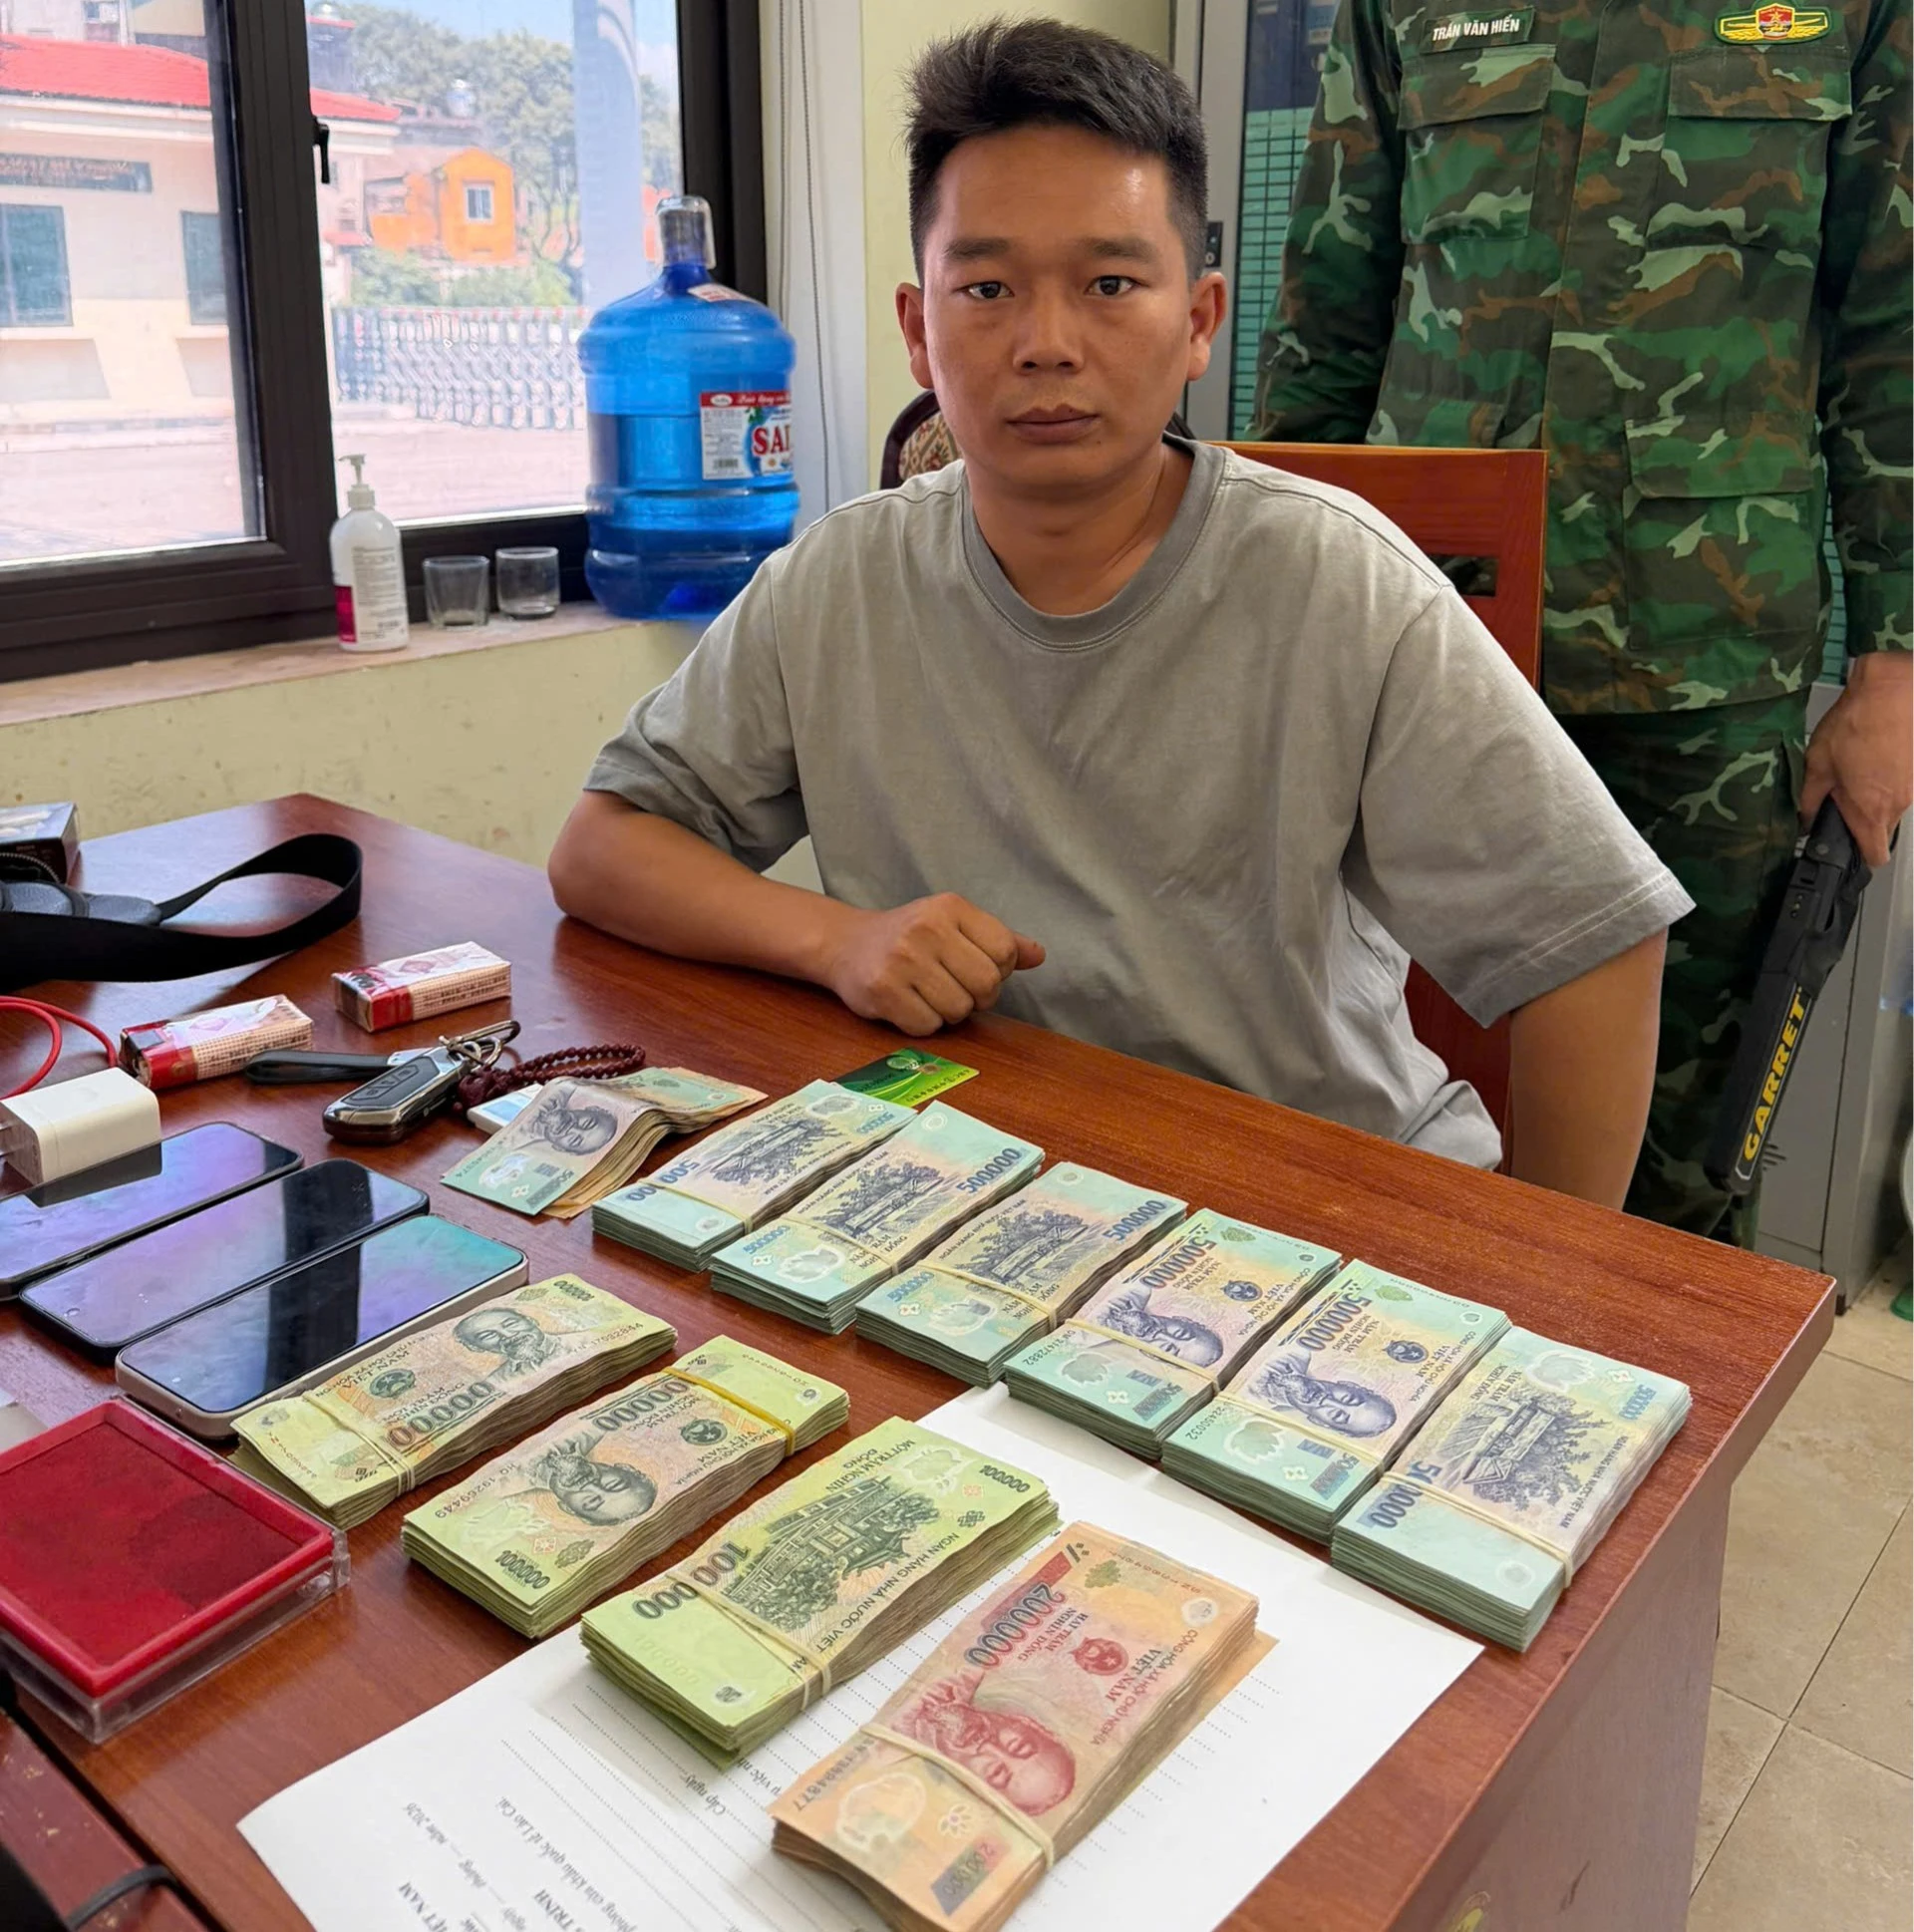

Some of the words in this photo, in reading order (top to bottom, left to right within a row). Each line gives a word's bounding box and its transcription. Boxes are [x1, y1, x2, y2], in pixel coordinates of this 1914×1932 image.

[1463, 20, 1488, 36] VĂN
[1745, 991, 1805, 1160] GARRET
[620, 1158, 704, 1202] 50000
[1428, 1343, 1451, 1362] VIỆT
[338, 1369, 378, 1390] VIỆT
[372, 1350, 414, 1371] NAM
[1414, 1360, 1436, 1378] NAM
[586, 1375, 694, 1436] 00000
[696, 1444, 728, 1463] NAM
[925, 1531, 962, 1556] NGÂN
[893, 1552, 933, 1578] HÀNG
[868, 1575, 903, 1599] NHÀ
[832, 1596, 881, 1629] NƯỚC
[1067, 1612, 1089, 1629] HAI
[808, 1627, 846, 1652] VIỆT
[1126, 1645, 1162, 1676] VIỆT
[1103, 1673, 1136, 1703] NAM
